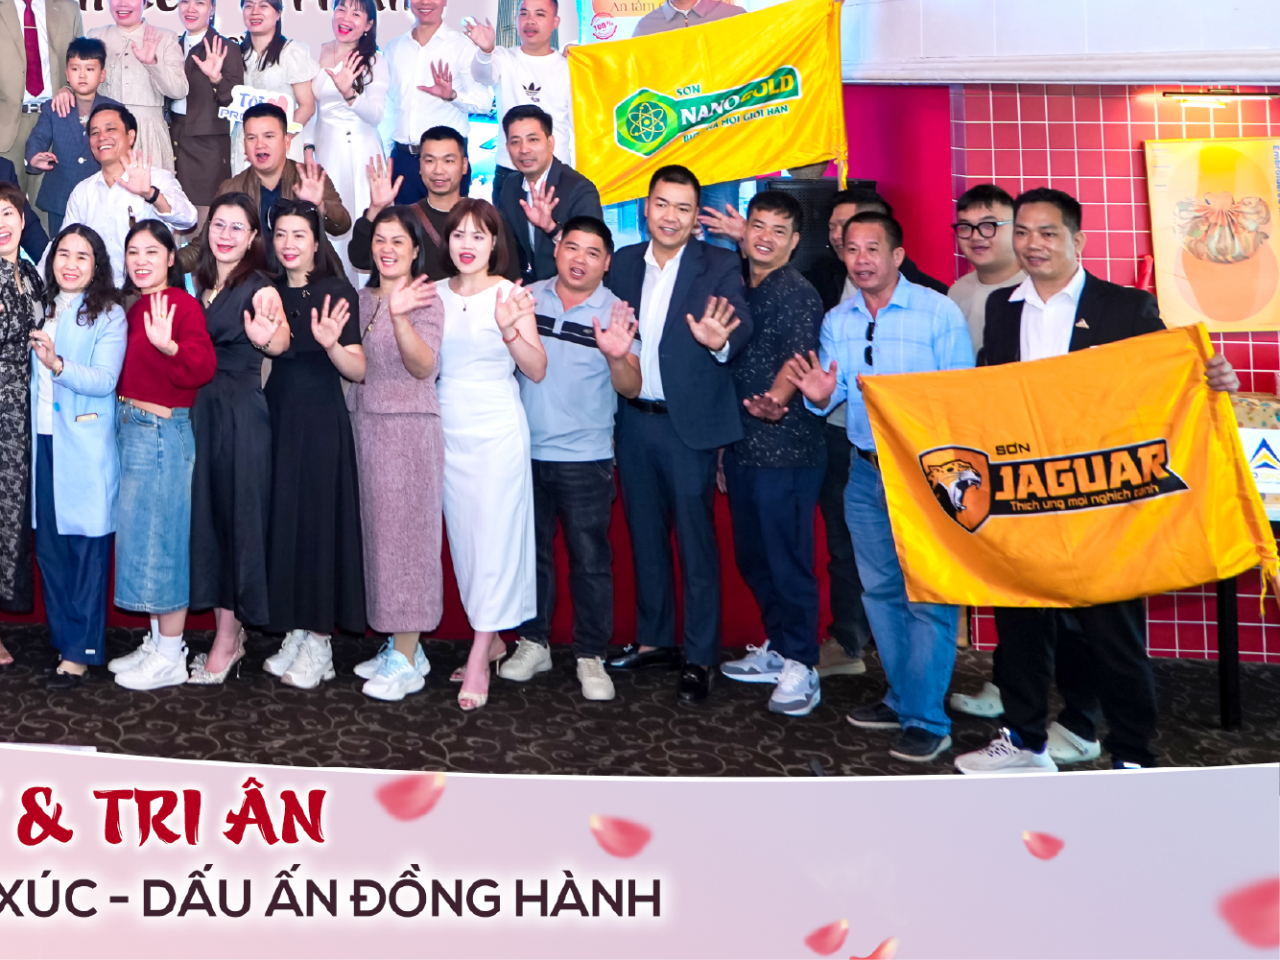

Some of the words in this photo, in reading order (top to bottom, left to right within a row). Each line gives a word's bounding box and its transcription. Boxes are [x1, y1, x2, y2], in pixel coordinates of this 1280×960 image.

[676, 84, 701, 97] SƠN
[996, 442, 1031, 456] SƠN
[995, 443, 1170, 501] JAGUAR
